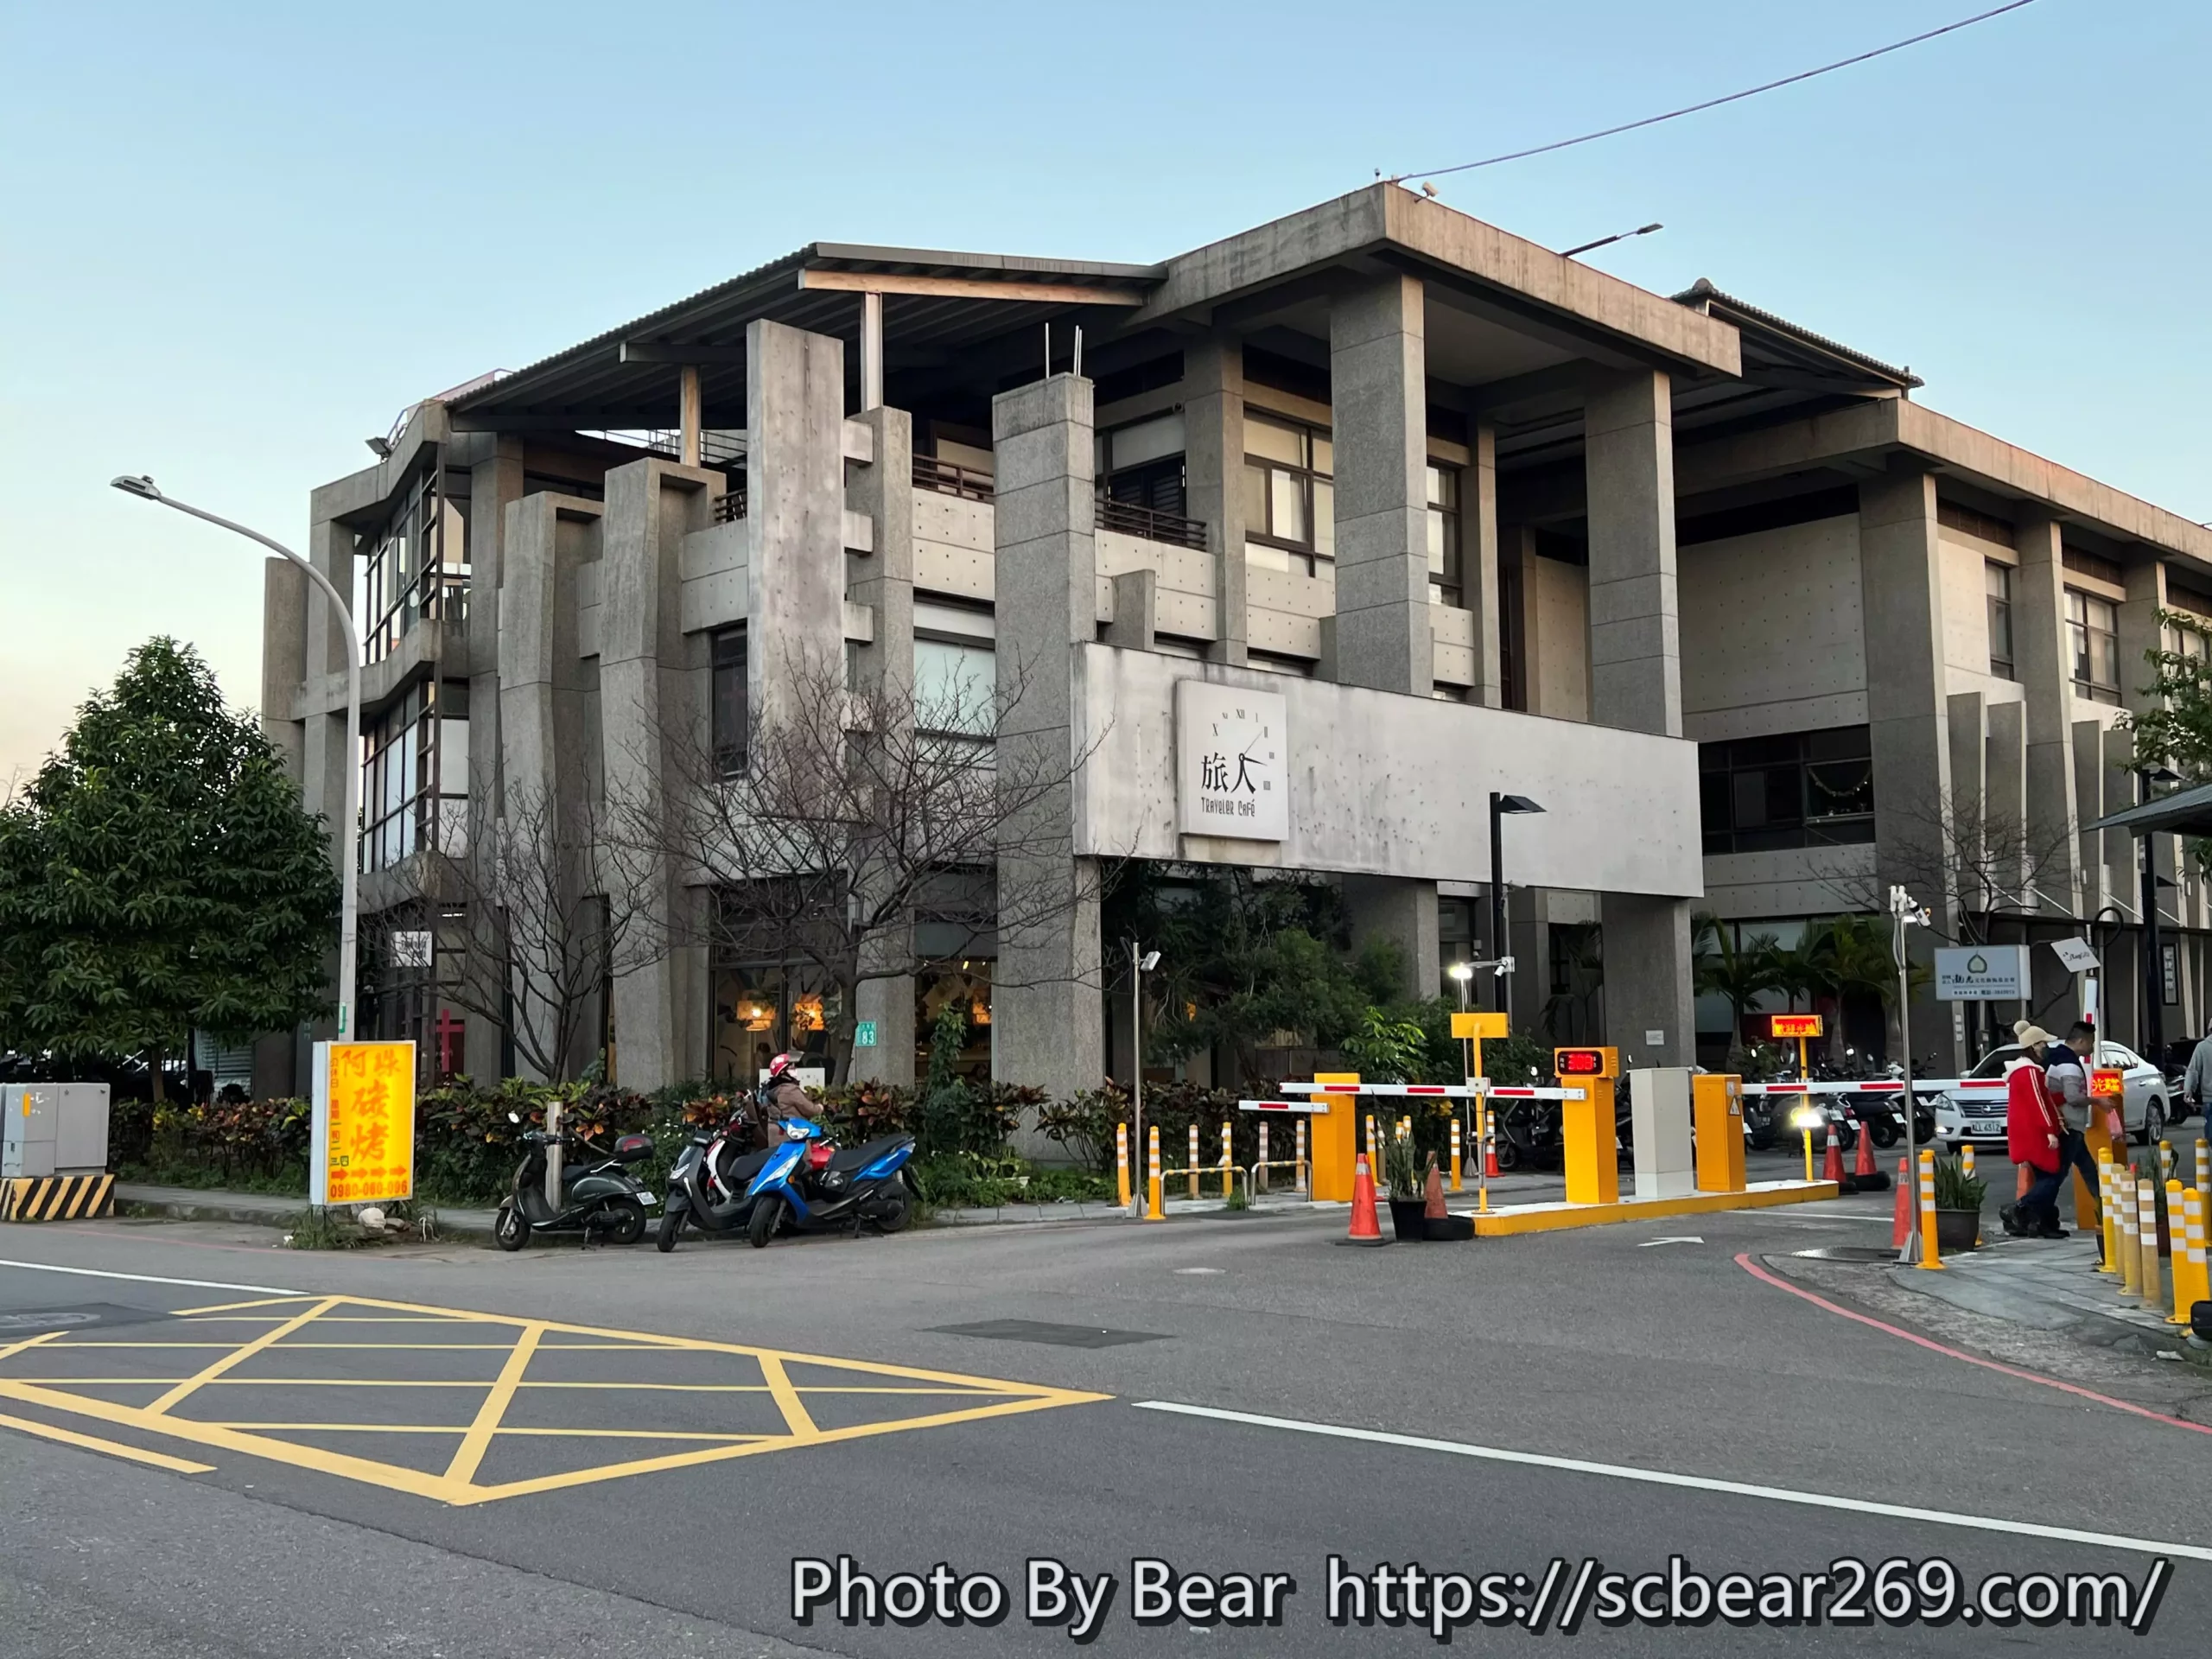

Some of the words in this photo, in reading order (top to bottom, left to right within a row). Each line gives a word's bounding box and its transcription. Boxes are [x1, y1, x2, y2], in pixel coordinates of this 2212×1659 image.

[1200, 752, 1256, 794] 旅人
[861, 1031, 874, 1045] 83
[351, 1079, 389, 1163] 碳烤
